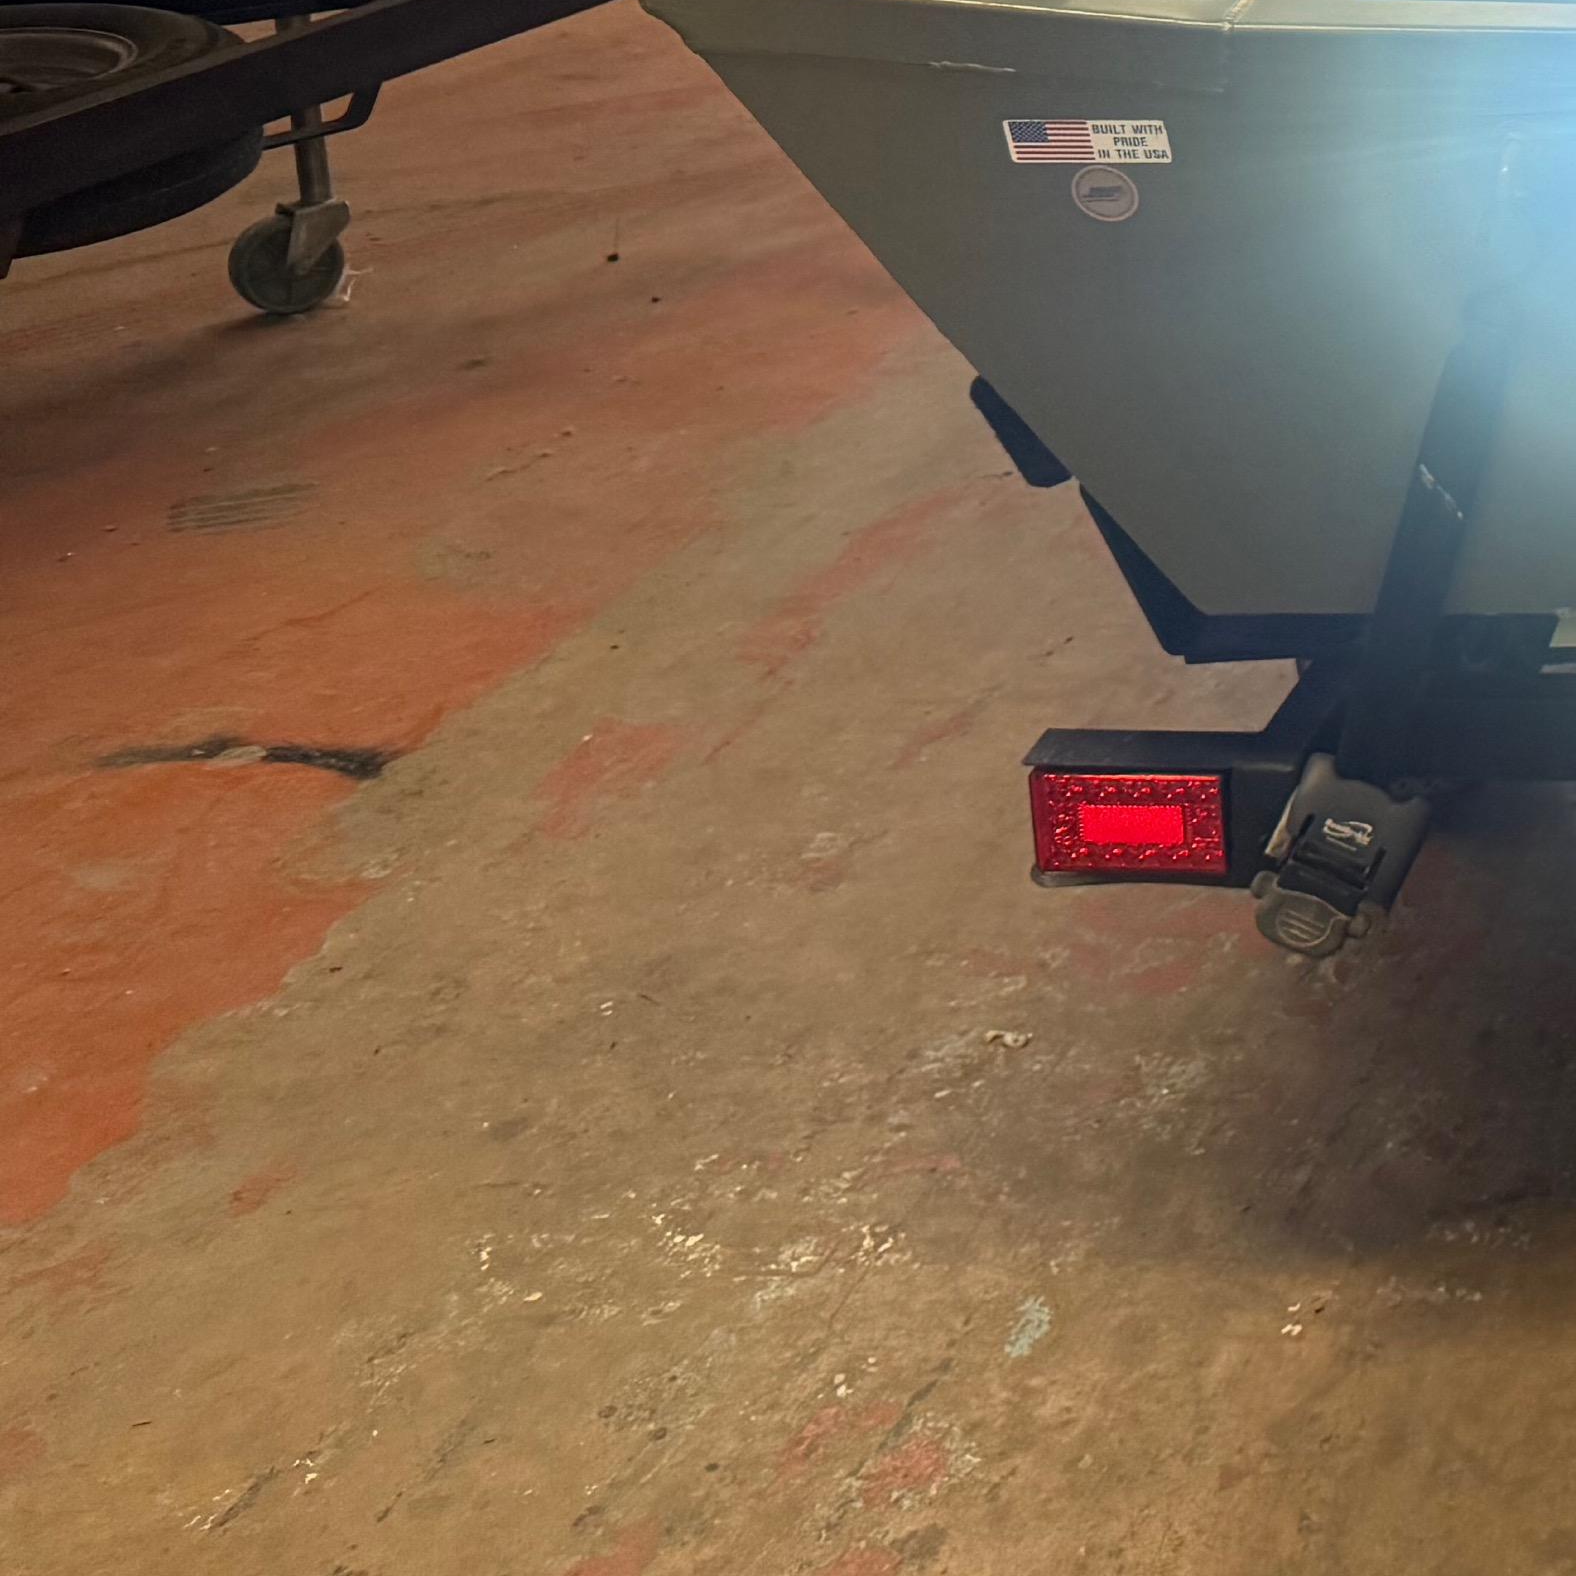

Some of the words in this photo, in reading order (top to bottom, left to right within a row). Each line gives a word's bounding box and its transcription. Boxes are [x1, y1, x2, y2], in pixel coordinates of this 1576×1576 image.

[1091, 124, 1126, 135] BUILT
[1131, 124, 1164, 136] WITH
[1113, 136, 1148, 147] PRIDE
[1098, 149, 1111, 159] IN
[1114, 149, 1140, 160] THE
[1143, 149, 1170, 160] USA
